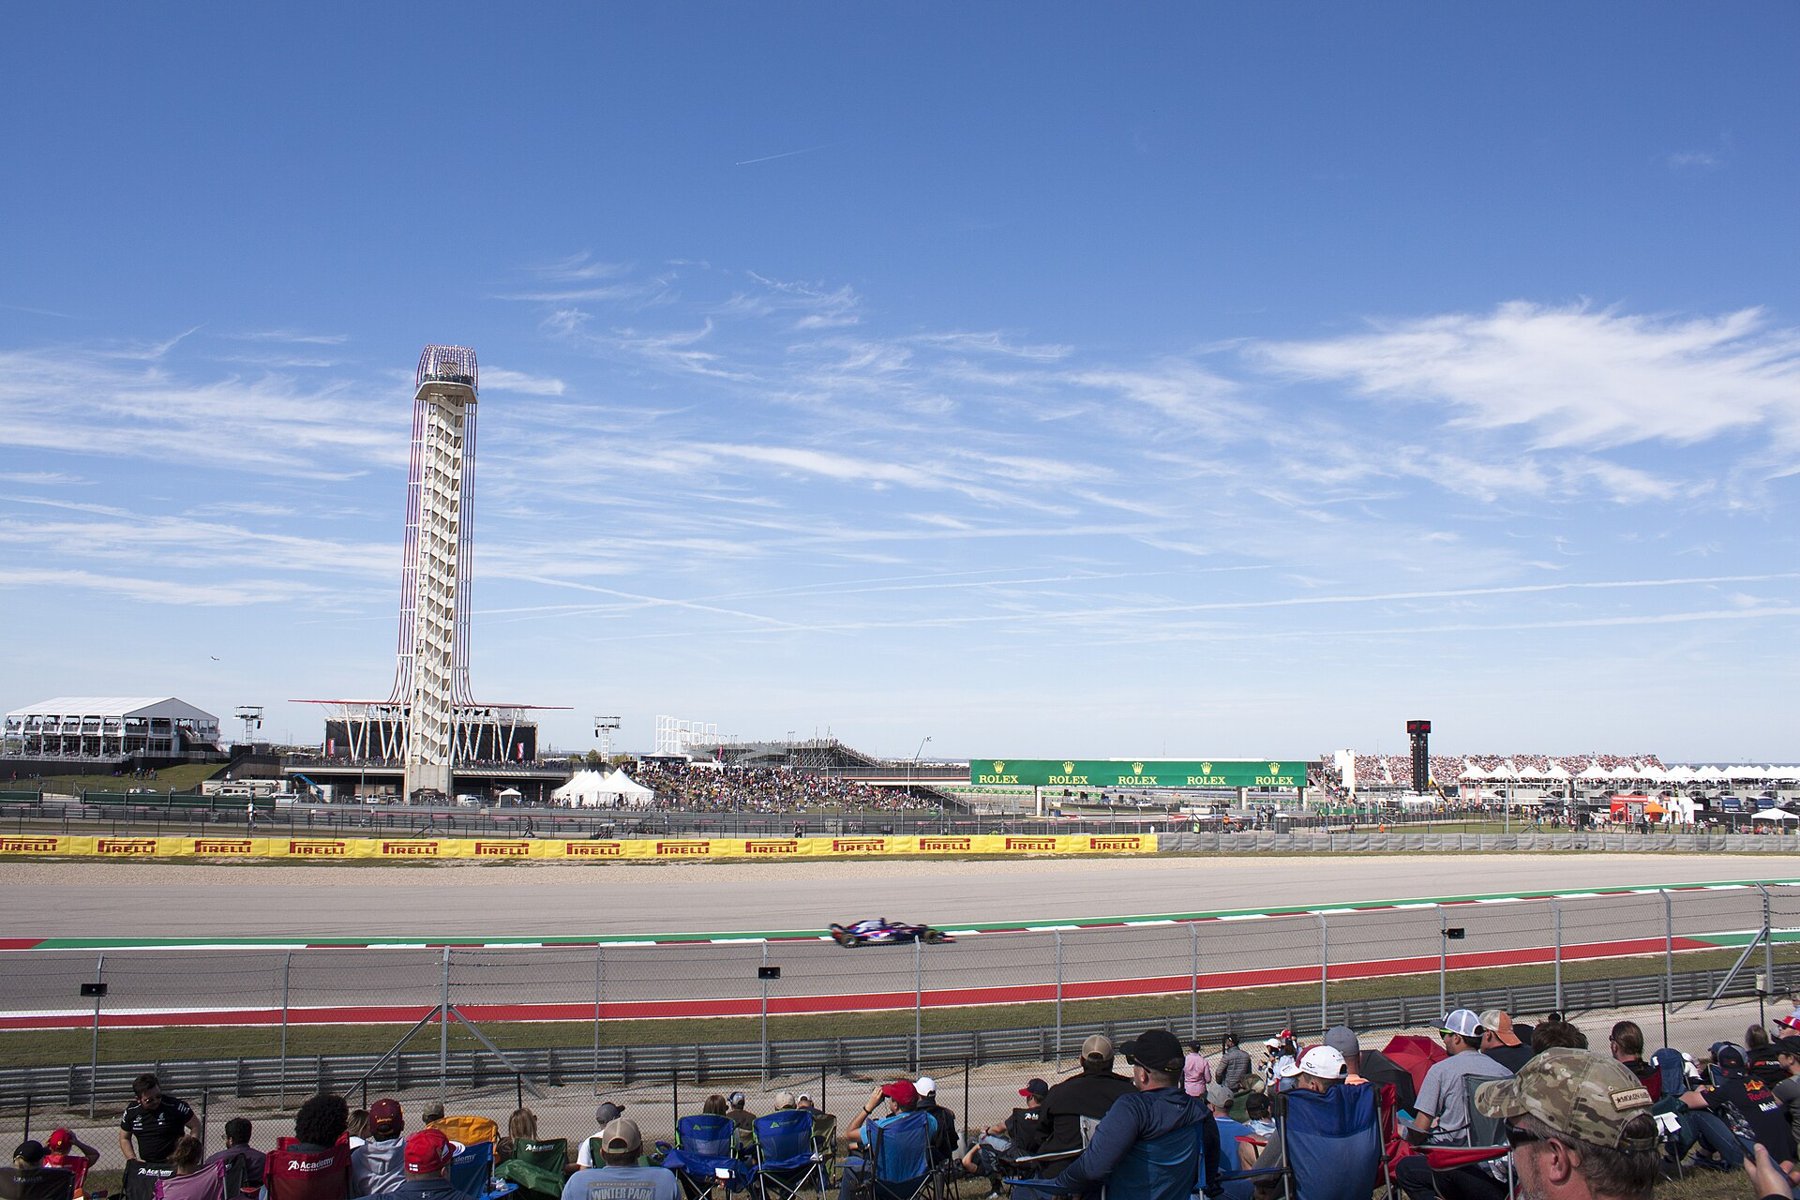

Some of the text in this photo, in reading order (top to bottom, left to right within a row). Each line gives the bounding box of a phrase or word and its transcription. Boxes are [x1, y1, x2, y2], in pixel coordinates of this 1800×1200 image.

[980, 775, 1018, 785] ROLEX
[1049, 776, 1088, 785] ROLEX
[1118, 776, 1157, 786] ROLEX
[1187, 776, 1225, 786] ROLEX
[1255, 776, 1294, 786] ROLEX
[98, 840, 156, 853] PIRELLI
[195, 840, 251, 852] PIRELLI
[290, 841, 345, 854] PIRELLI
[383, 841, 438, 854] PIRELLI
[475, 842, 529, 854] PIRELLI
[567, 842, 620, 854] PIRELLI
[656, 842, 709, 855] PIRELLI
[745, 841, 798, 853] PIRELLI
[833, 840, 885, 852] PIRELLI
[920, 839, 971, 850] PIRELLI
[1006, 838, 1056, 849] PIRELLI
[1090, 838, 1140, 849] PIRELLI
[300, 1156, 335, 1169] Academy
[591, 1188, 654, 1200] WINTER PARK
